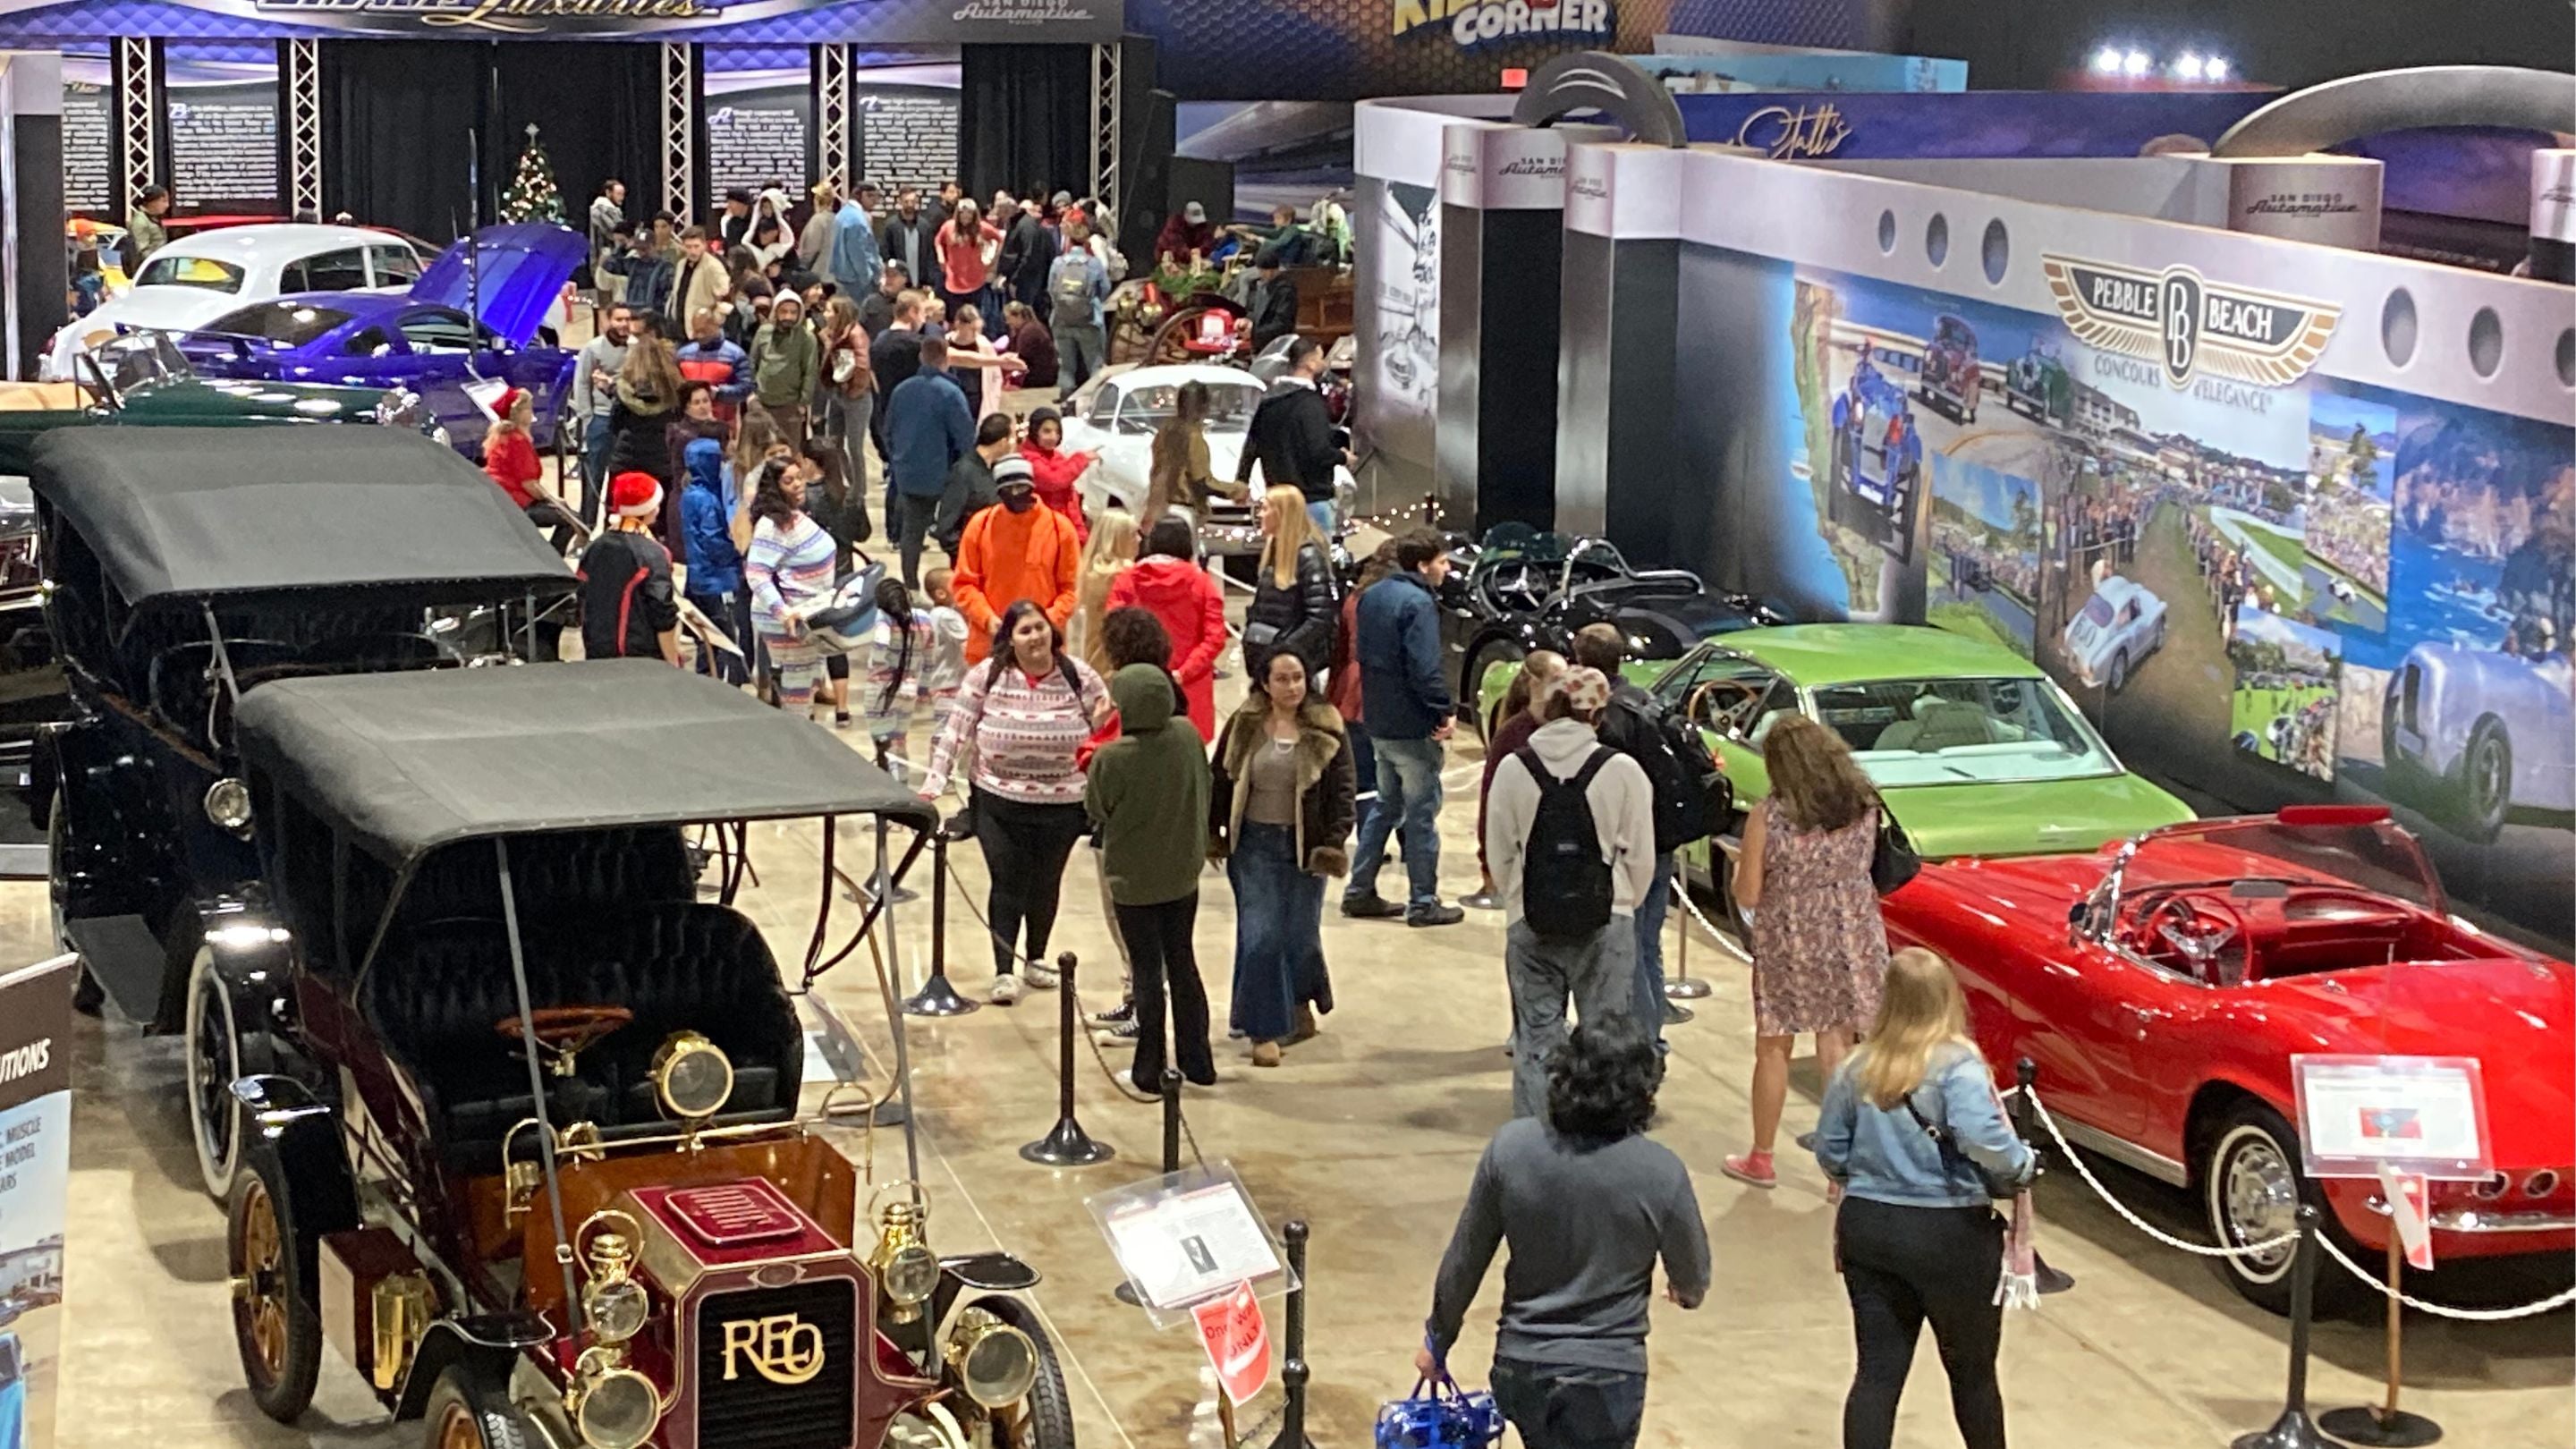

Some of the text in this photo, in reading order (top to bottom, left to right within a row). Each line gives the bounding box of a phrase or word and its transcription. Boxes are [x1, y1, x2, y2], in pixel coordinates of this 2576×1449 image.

[953, 2, 1096, 21] Automotive
[1453, 0, 1606, 45] CORNER
[2093, 276, 2273, 341] PEBBLE BEACH
[2094, 354, 2161, 388] CONCOURS
[721, 1311, 825, 1385] REO
